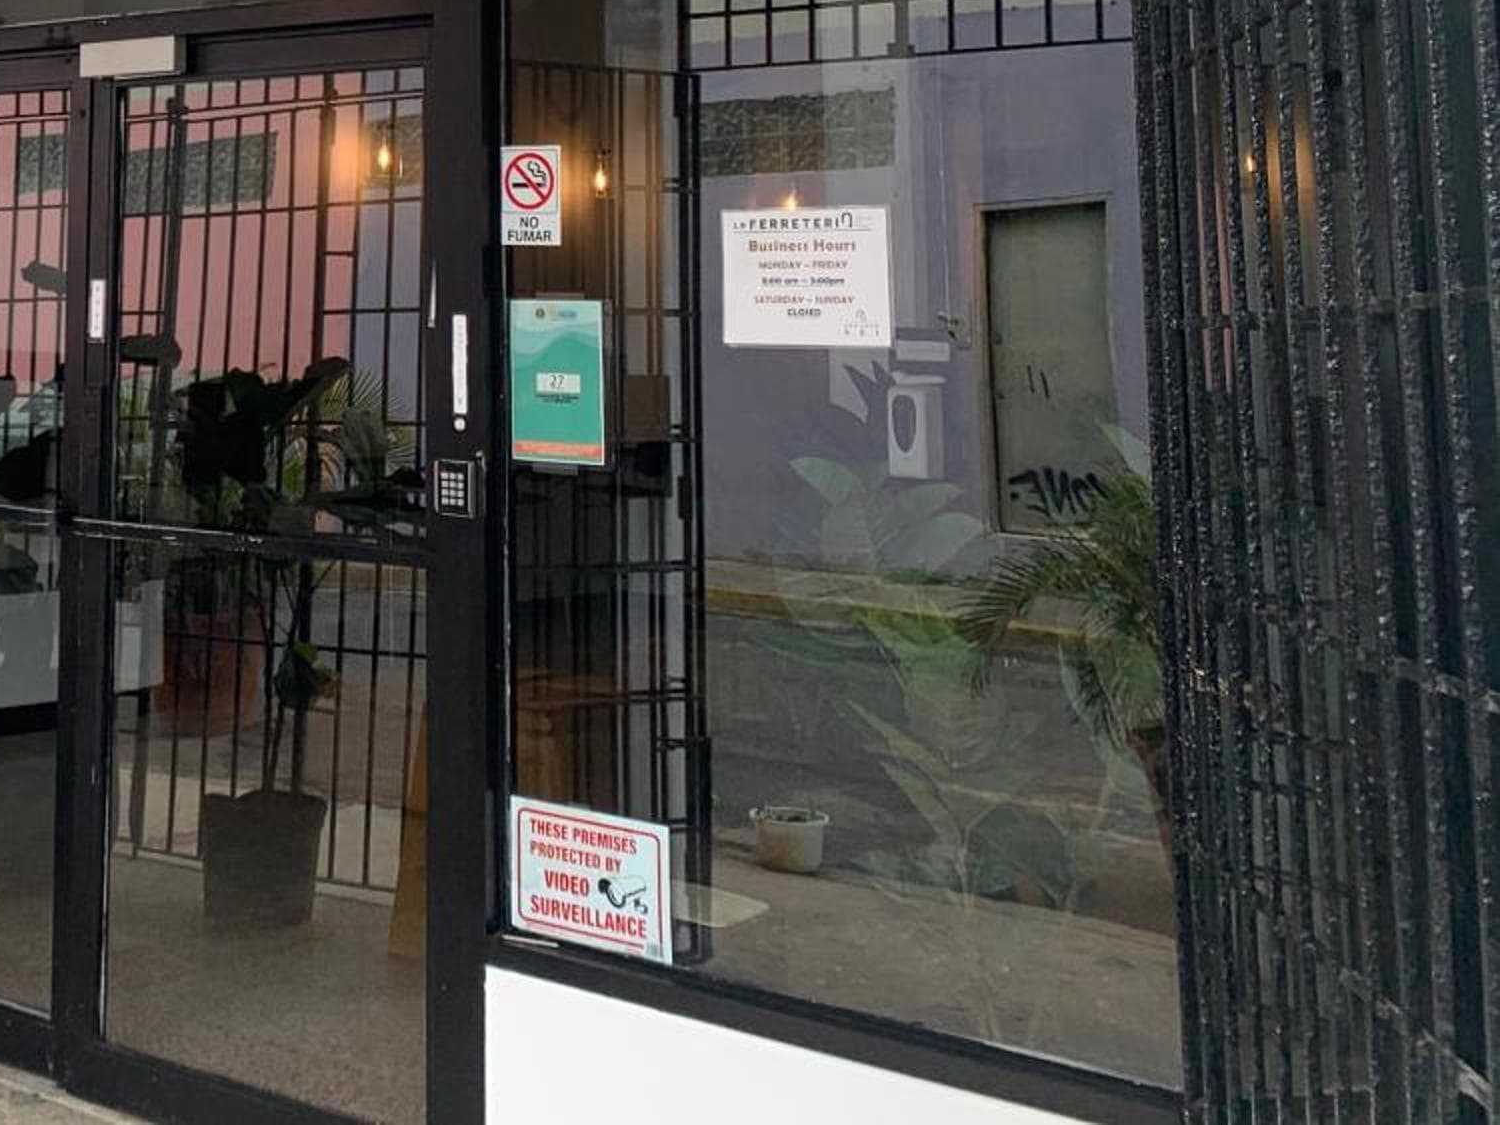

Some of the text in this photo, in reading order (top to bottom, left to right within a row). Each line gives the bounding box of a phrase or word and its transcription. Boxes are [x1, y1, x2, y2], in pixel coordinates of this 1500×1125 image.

[520, 216, 539, 229] NO
[507, 230, 552, 242] FUMAR
[749, 238, 856, 252] Business Hours
[758, 260, 802, 269] MONDAY
[812, 260, 847, 269] FRIDAY
[754, 295, 804, 304] SATURDAY
[815, 295, 854, 304] SUNDAY
[787, 308, 821, 316] CLOSED
[530, 818, 637, 855] THESE PREMISES
[530, 840, 623, 873] PROTECTED BY
[544, 869, 590, 897] VIDEO
[531, 894, 647, 939] SURVEILLANCE
